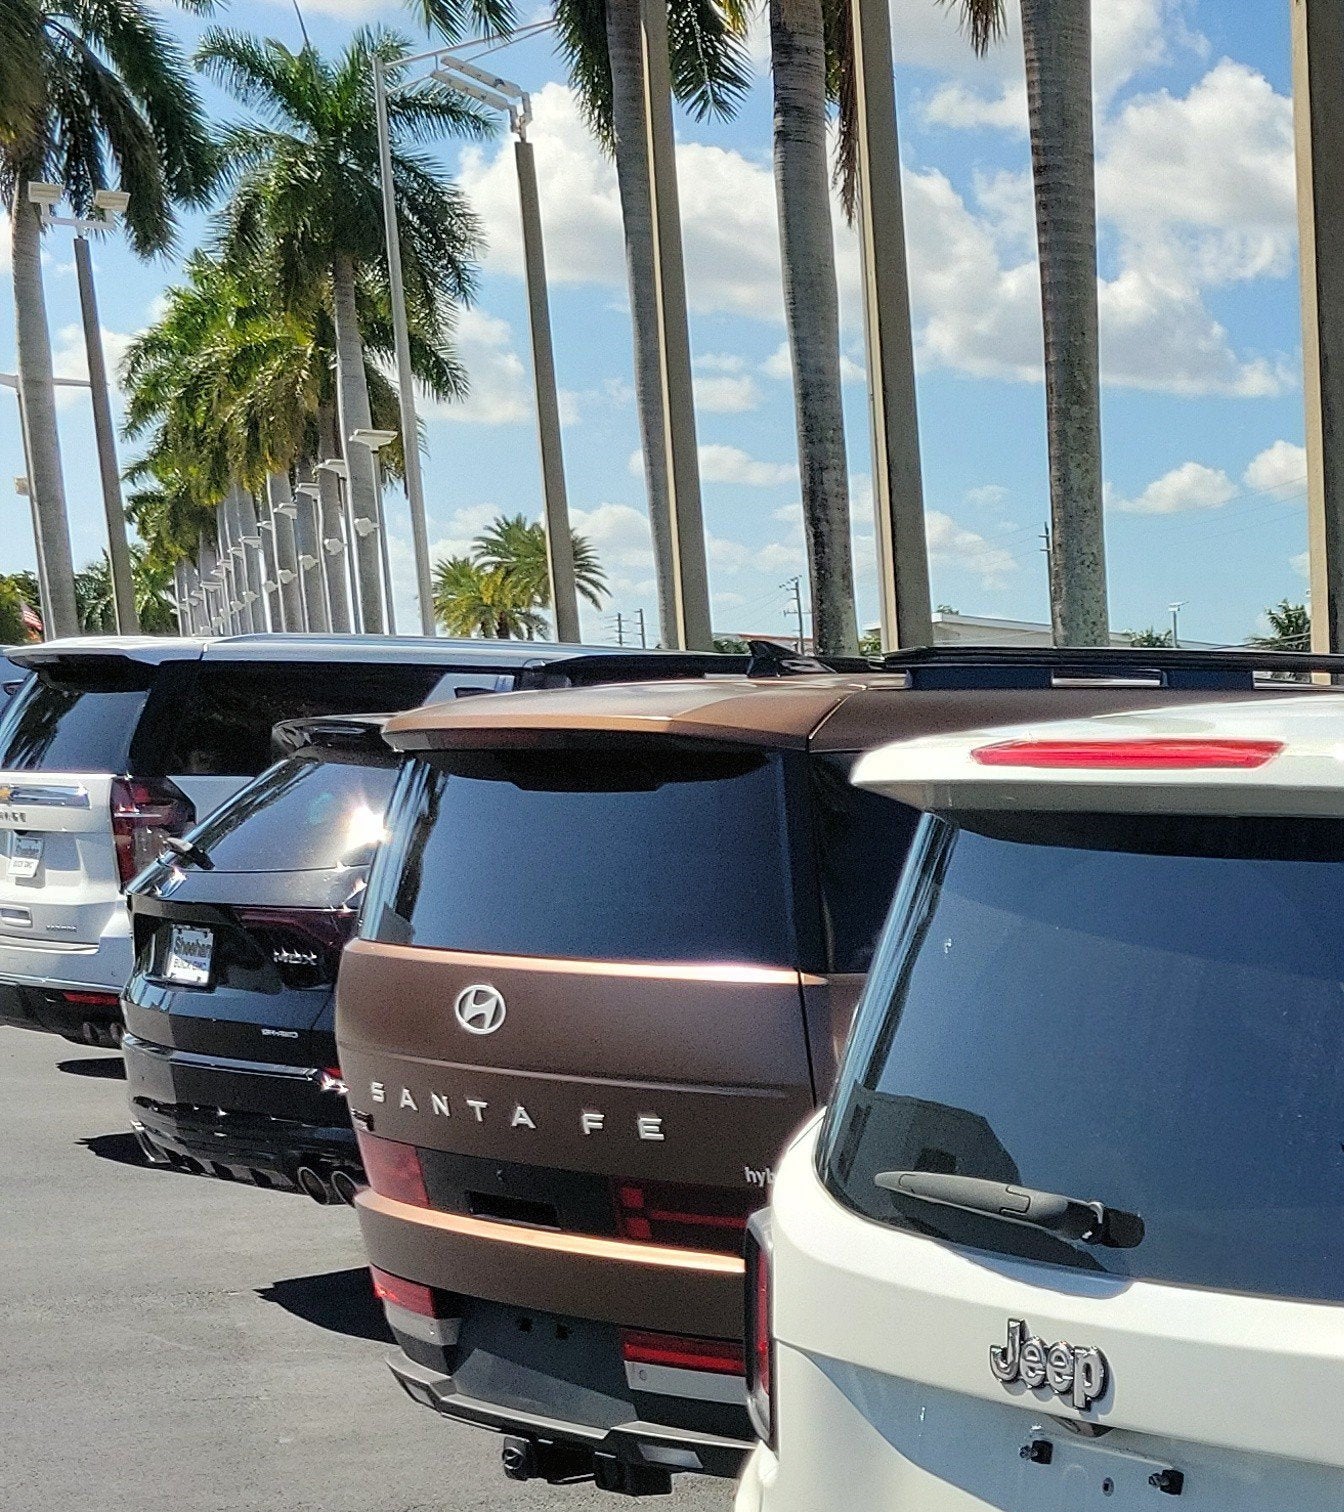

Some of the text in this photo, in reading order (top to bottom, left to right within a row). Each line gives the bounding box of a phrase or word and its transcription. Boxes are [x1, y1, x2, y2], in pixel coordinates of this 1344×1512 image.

[371, 1081, 536, 1129] SANTA
[582, 1112, 665, 1141] FE
[990, 1318, 1110, 1412] Jeep
